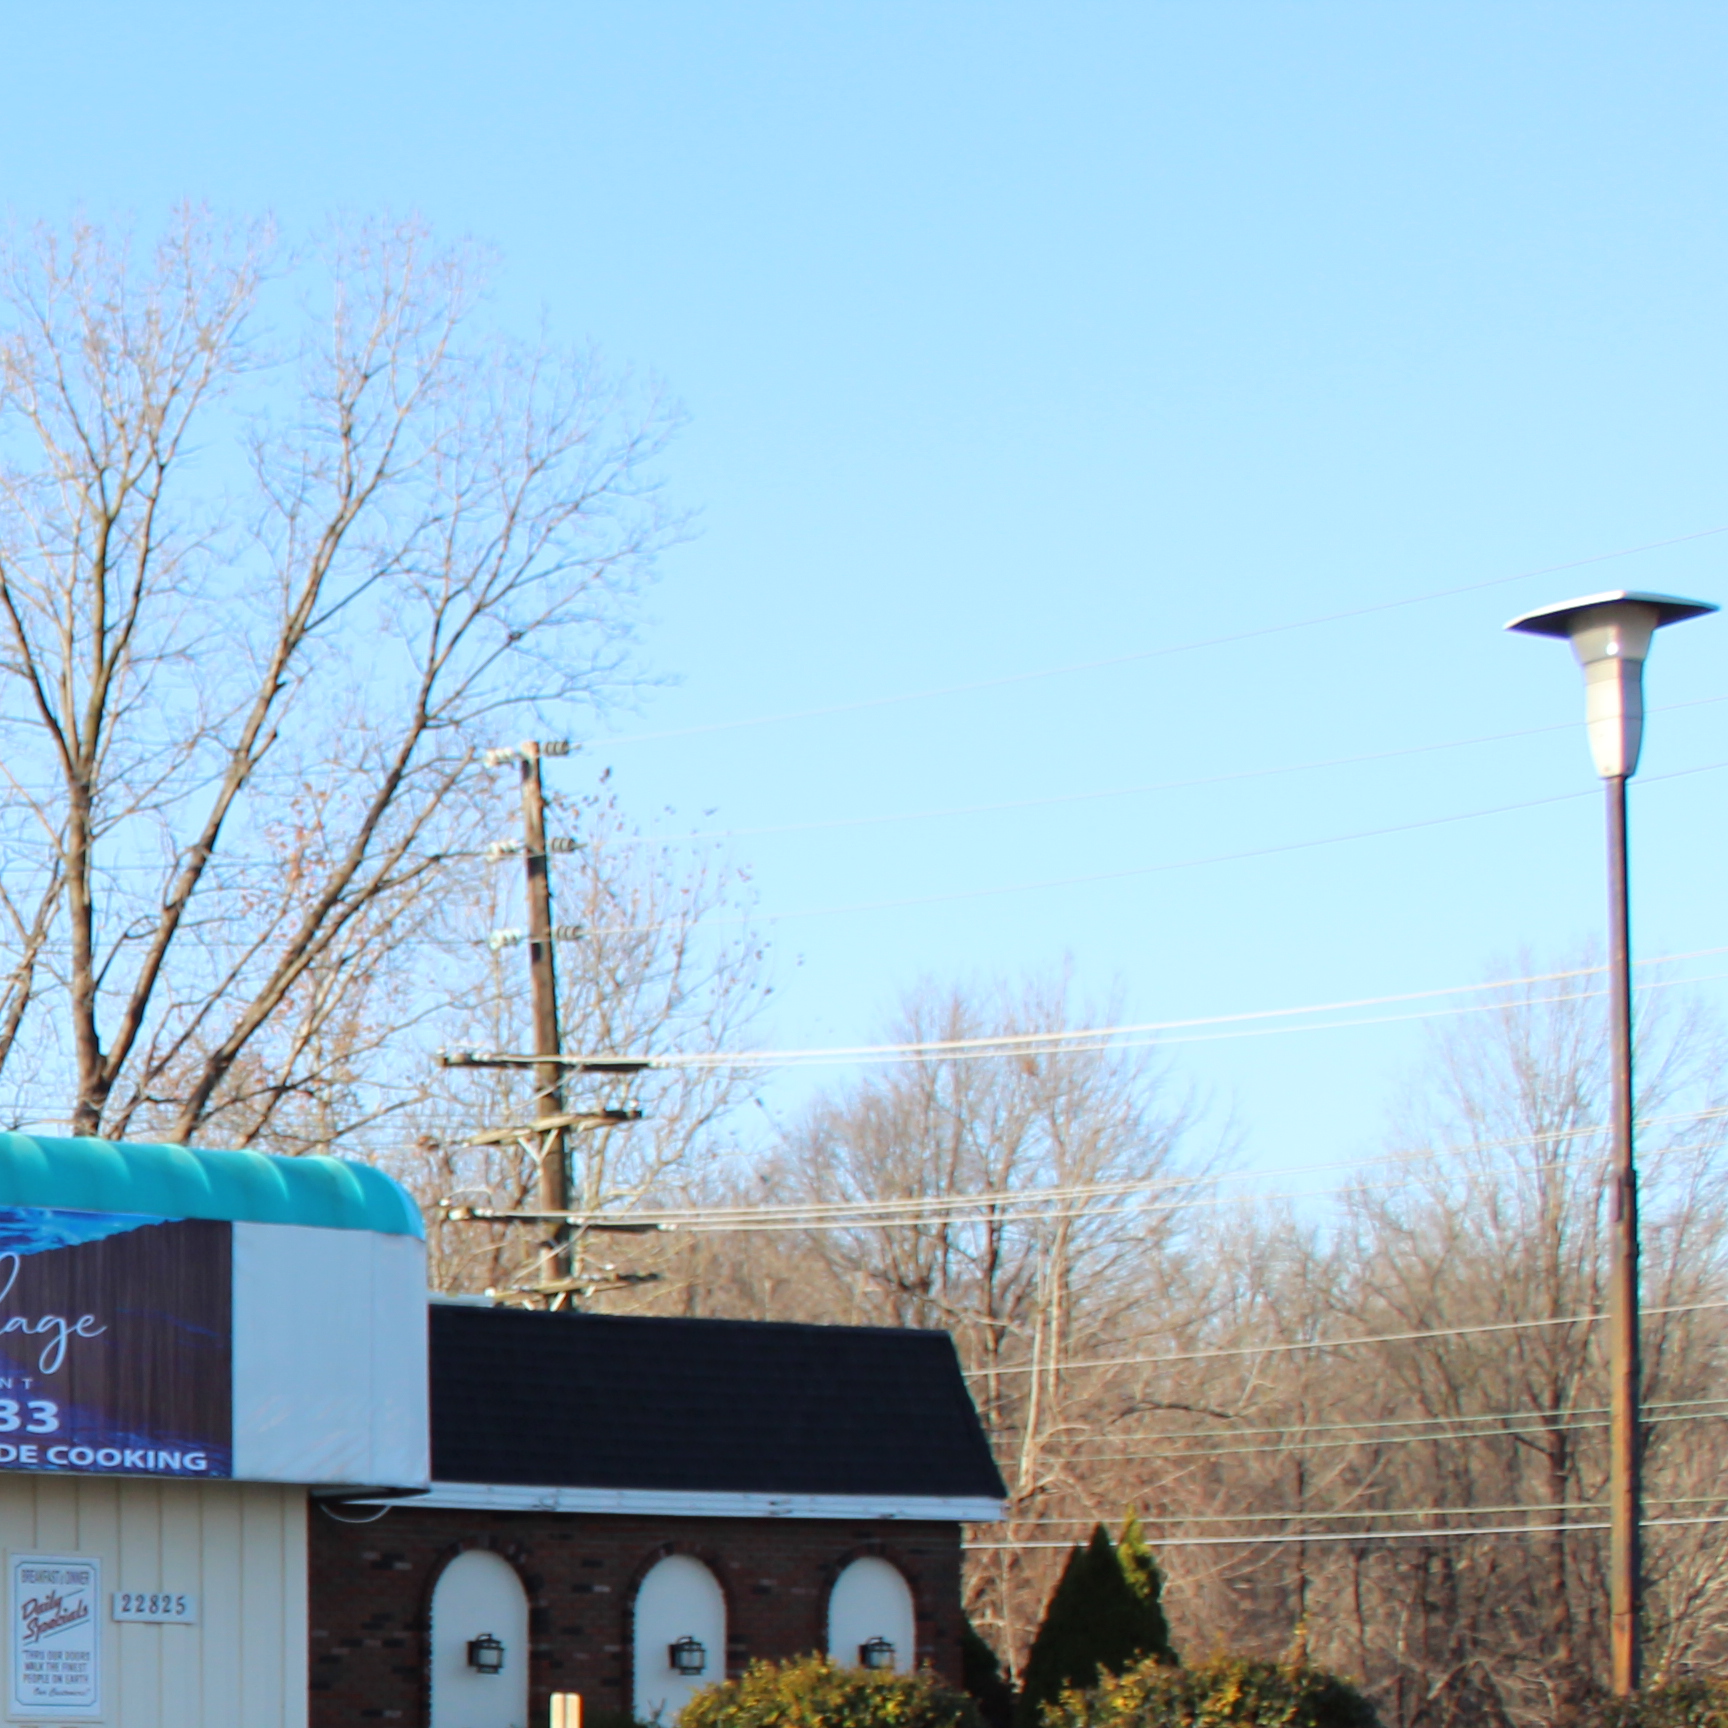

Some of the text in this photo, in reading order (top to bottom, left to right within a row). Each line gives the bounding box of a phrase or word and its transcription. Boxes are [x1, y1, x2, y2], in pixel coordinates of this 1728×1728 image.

[46, 1446, 208, 1471] COOKING
[21, 1589, 63, 1620] Daily
[121, 1593, 187, 1616] 22825
[22, 1599, 89, 1643] Specials
